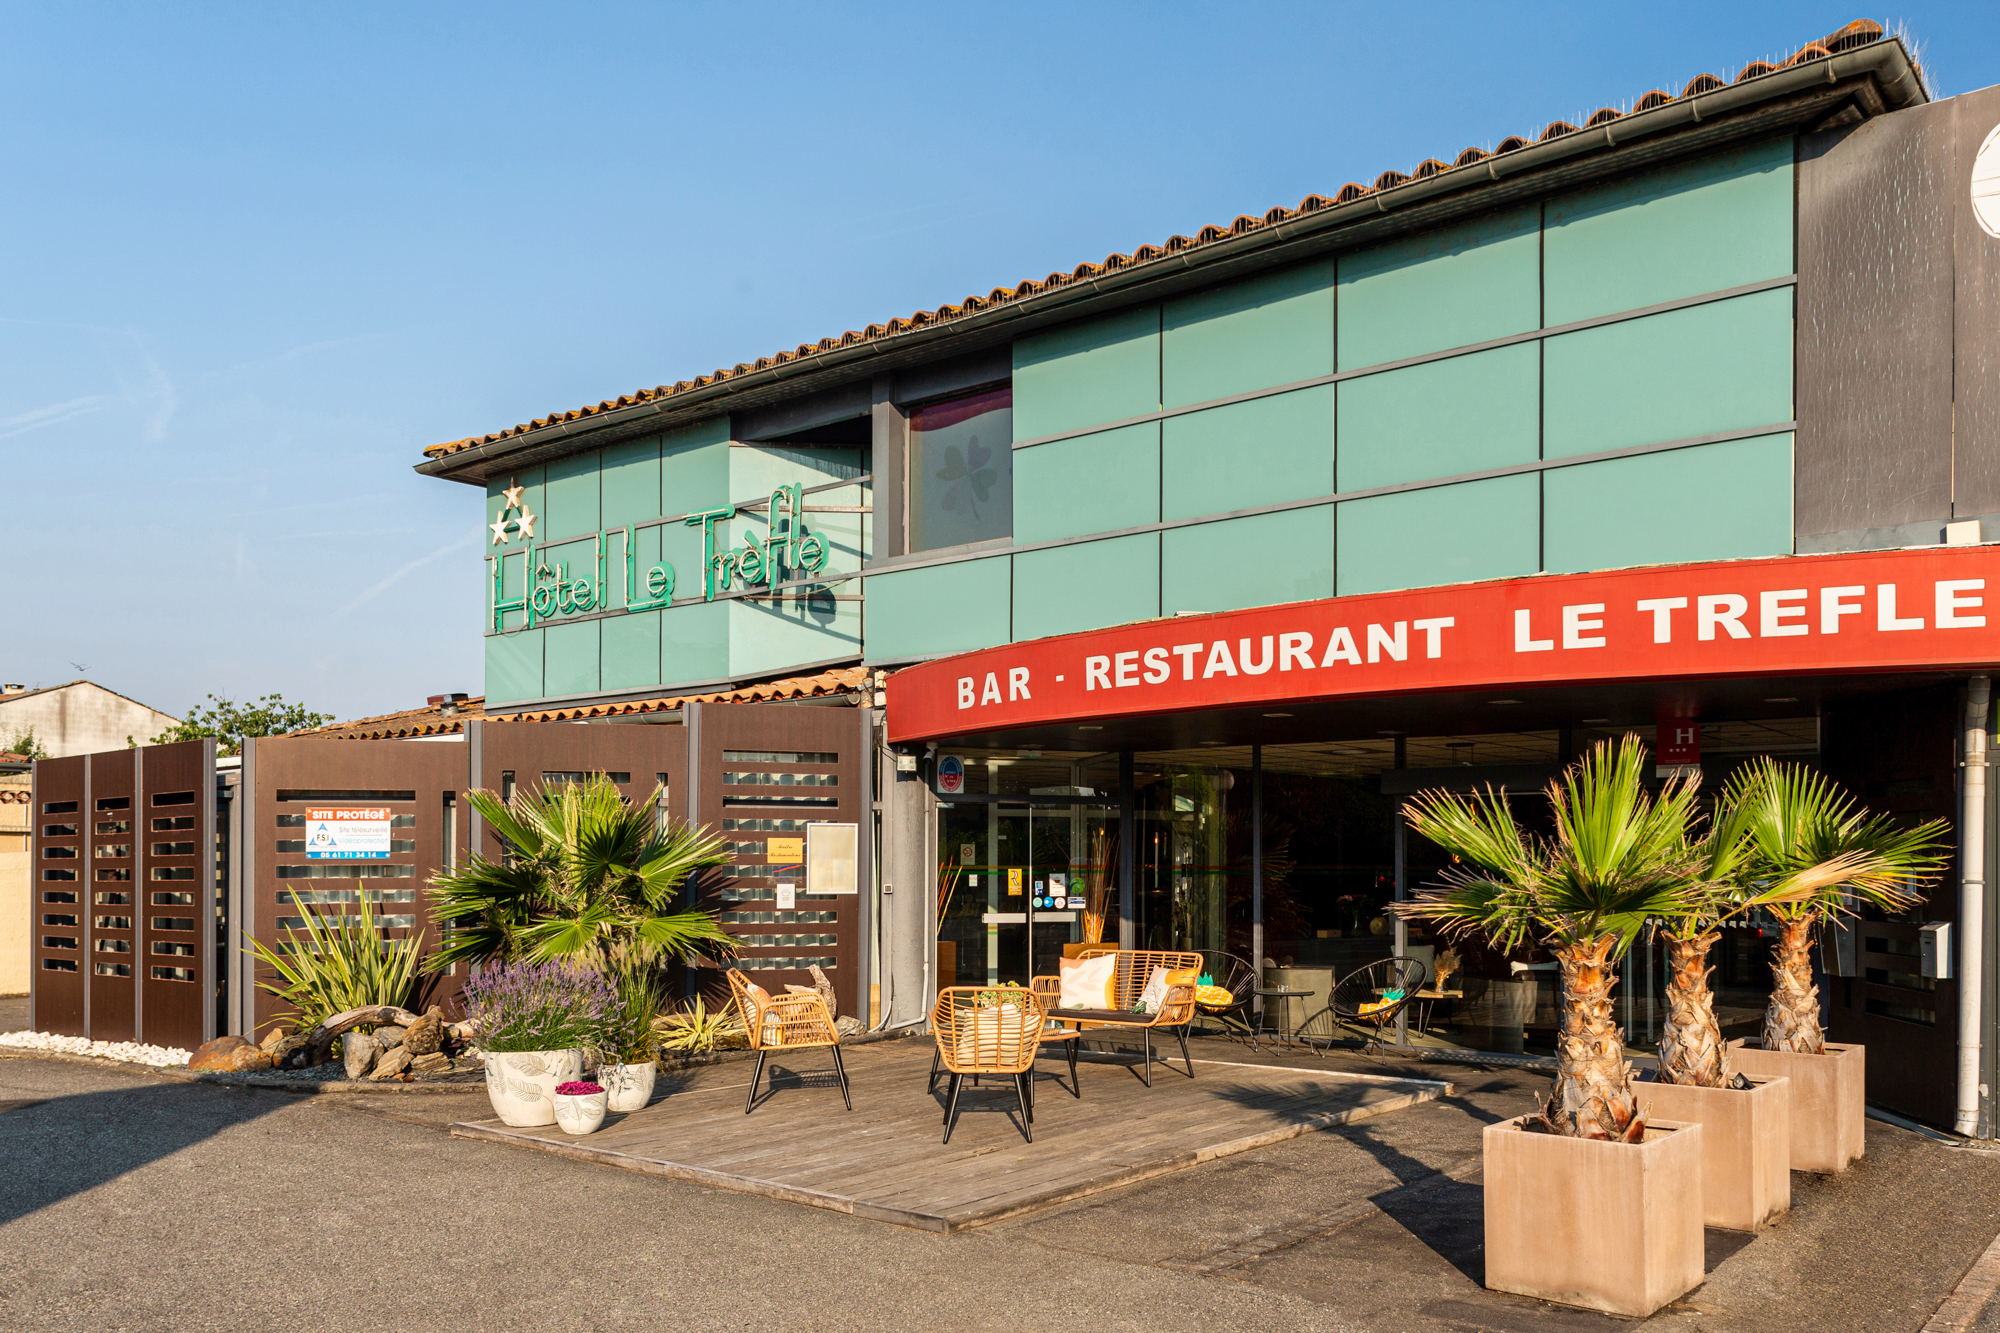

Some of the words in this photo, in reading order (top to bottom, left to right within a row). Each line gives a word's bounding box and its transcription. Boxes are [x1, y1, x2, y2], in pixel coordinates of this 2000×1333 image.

[491, 529, 607, 633] Hôtel
[623, 523, 675, 613] Le
[682, 482, 830, 602] Trèfle
[958, 666, 1032, 709] BAR
[1085, 616, 1455, 691] RESTAURANT
[1514, 603, 1606, 653] LE
[1637, 578, 1987, 644] TREFLE
[1675, 728, 1694, 745] H
[312, 811, 334, 819] SITE
[336, 809, 385, 819] PROTÉGÉ
